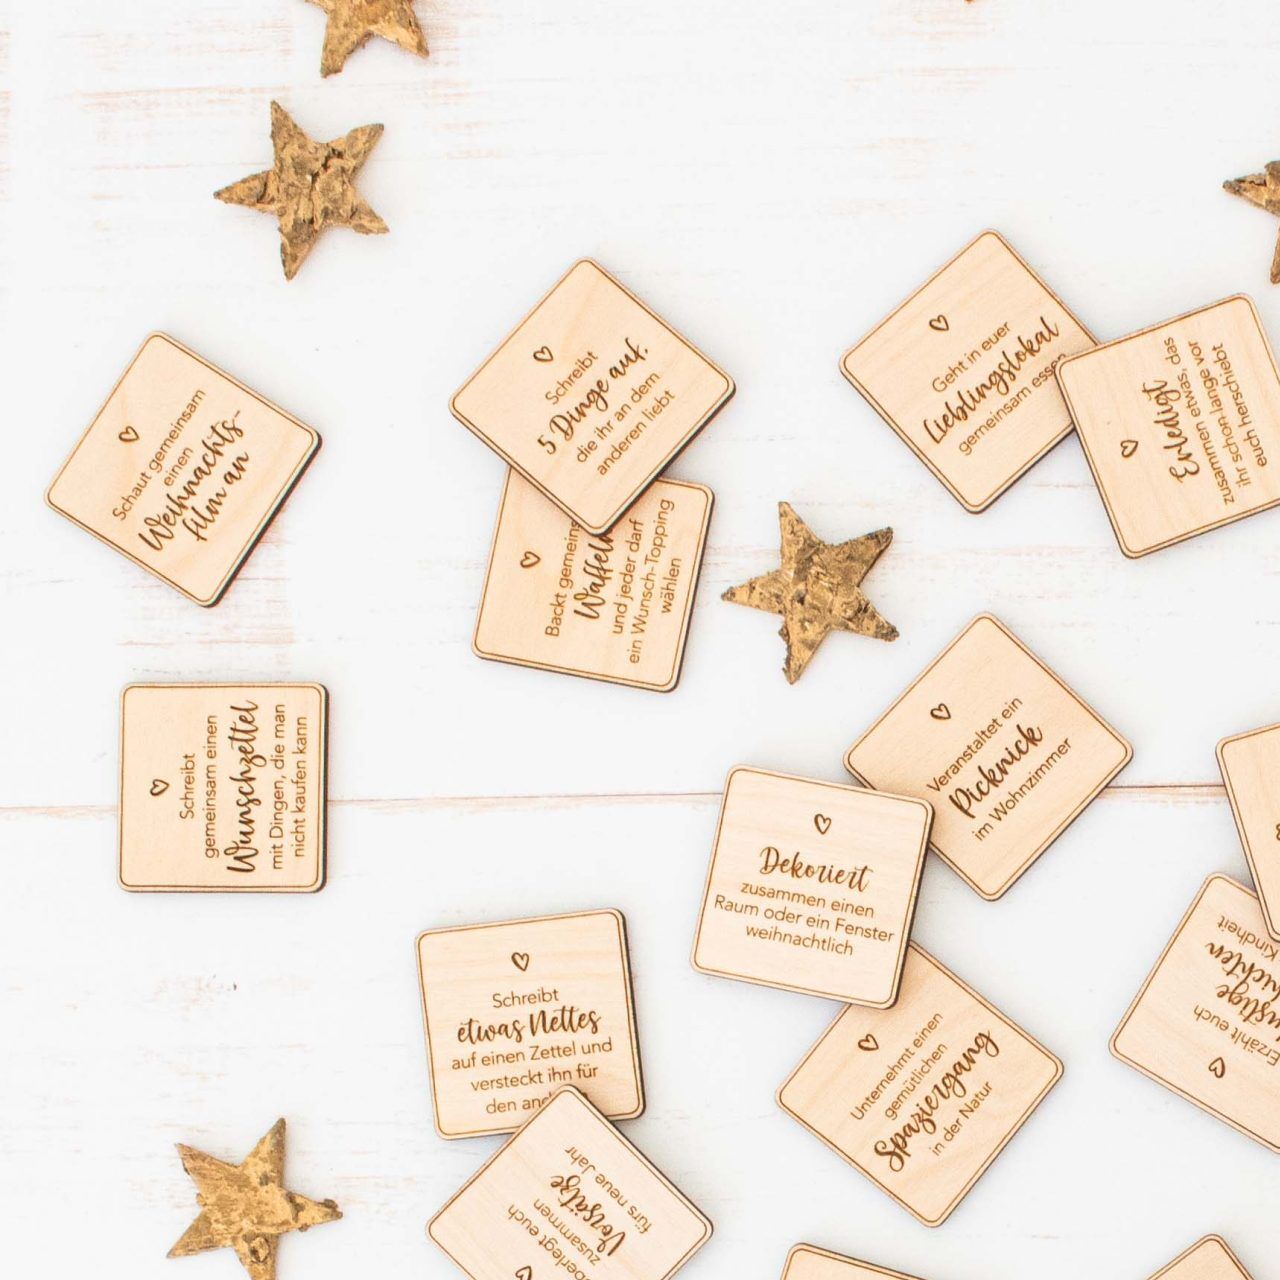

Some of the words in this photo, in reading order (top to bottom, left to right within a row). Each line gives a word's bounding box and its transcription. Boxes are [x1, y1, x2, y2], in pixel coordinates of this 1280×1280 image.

[931, 360, 969, 393] Geht
[963, 349, 982, 364] in
[981, 321, 1011, 352] euer
[1163, 336, 1182, 366] das
[1187, 341, 1205, 367] vor
[544, 351, 599, 406] Schreibt
[922, 315, 1060, 445] Lieblingslokal
[1177, 368, 1202, 418] etwas,
[1199, 368, 1224, 415] lange
[1211, 342, 1252, 428] herschiebt
[536, 434, 557, 455] 5
[549, 379, 610, 442] Dinge
[576, 440, 598, 463] die
[593, 419, 614, 441] ihr
[614, 403, 632, 422] an
[630, 372, 661, 404] dem
[596, 421, 647, 476] anderen
[641, 390, 675, 422] liebt
[958, 386, 1032, 456] gemeinsam
[1141, 380, 1201, 484] Erledigt
[1217, 413, 1243, 463] schon
[111, 471, 152, 521] Schaut
[148, 389, 206, 471] gemeinsam
[163, 447, 194, 487] einen
[1195, 420, 1235, 505] zusammen
[1243, 428, 1268, 468] euch
[137, 410, 244, 552] Weihnachts-
[181, 487, 227, 542] film
[223, 452, 250, 486] an
[1235, 466, 1252, 488] ihr
[625, 517, 644, 553] darf
[544, 592, 568, 637] Backt
[558, 522, 584, 590] gemeins
[615, 555, 637, 602] jeder
[630, 498, 675, 635] Wunsch-Topping
[659, 557, 682, 614] wählen
[612, 601, 628, 635] und
[626, 639, 643, 664] ein
[202, 715, 218, 760] einen
[274, 704, 286, 739] man
[291, 716, 308, 755] kann
[925, 718, 1003, 792] Veranstaltet
[1001, 697, 1023, 720] ein
[269, 743, 286, 770] die
[948, 723, 1043, 820] Picknick
[179, 753, 196, 820] Schreibt
[202, 764, 220, 859] gemeinsam
[223, 700, 267, 874] Wunschzettel
[268, 775, 287, 839] Dingen,
[290, 760, 307, 814] kaufen
[971, 822, 994, 841] im
[988, 737, 1072, 822] Wohnzimmer
[269, 843, 284, 870] mit
[290, 817, 306, 858] nicht
[759, 846, 874, 893] Dekoriert
[714, 893, 759, 917] Raum
[763, 906, 803, 924] oder
[805, 913, 830, 930] ein
[834, 917, 895, 942] Fenster
[740, 882, 826, 909] zusammen
[830, 898, 875, 919] einen
[745, 925, 854, 956] weihnachtlich
[1217, 915, 1279, 962] Kindheit
[492, 986, 559, 1009] Schreibt
[1193, 1004, 1230, 1032] euch
[457, 1017, 526, 1045] etwas
[529, 1005, 602, 1037] Nettes
[451, 1052, 477, 1071] auf
[481, 1051, 526, 1067] einen
[529, 1040, 577, 1061] Zettel
[580, 1036, 613, 1055] und
[470, 1070, 544, 1092] versteckt
[547, 1066, 573, 1083] ihn
[575, 1063, 599, 1079] für
[850, 1047, 916, 1121] Unternehmt
[912, 1013, 944, 1049] einen
[485, 1098, 517, 1115] den
[873, 1030, 1000, 1173] Spaziergang
[884, 1043, 948, 1121] gemütlichen
[928, 1142, 945, 1157] in
[943, 1117, 963, 1142] der
[958, 1081, 993, 1120] Natur
[564, 1146, 596, 1175] Jahr
[594, 1173, 628, 1207] neue
[507, 1204, 540, 1237] euch
[533, 1198, 601, 1266] zusammen
[550, 1174, 626, 1257] Vorsätze
[627, 1205, 652, 1235] fürs
